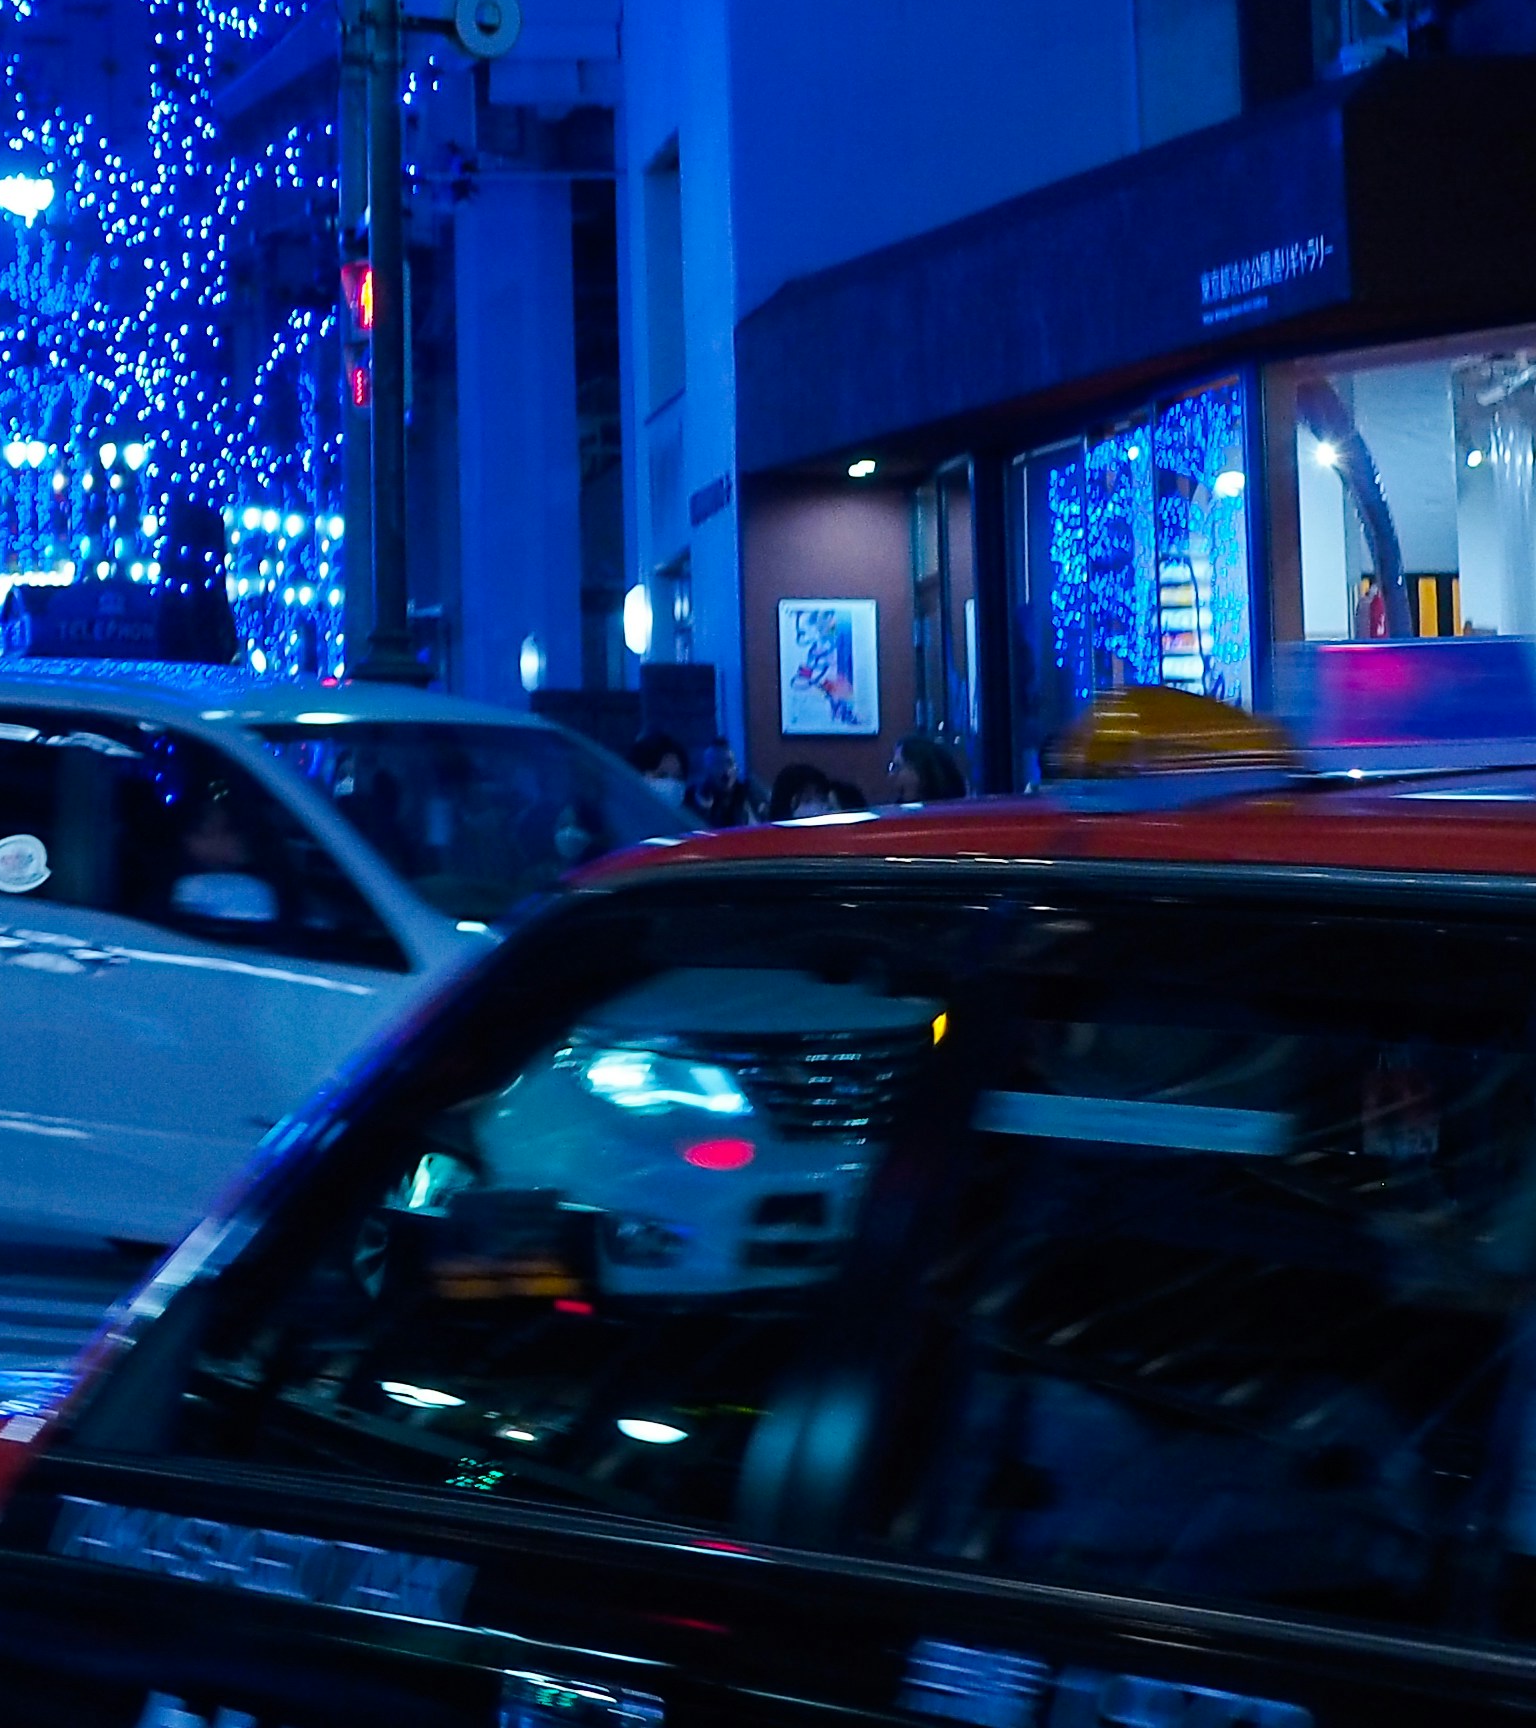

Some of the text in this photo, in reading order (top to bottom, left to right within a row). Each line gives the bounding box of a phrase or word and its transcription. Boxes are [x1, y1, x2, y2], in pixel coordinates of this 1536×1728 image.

[1200, 233, 1334, 306] 東京都渋谷公園通りギャラリー
